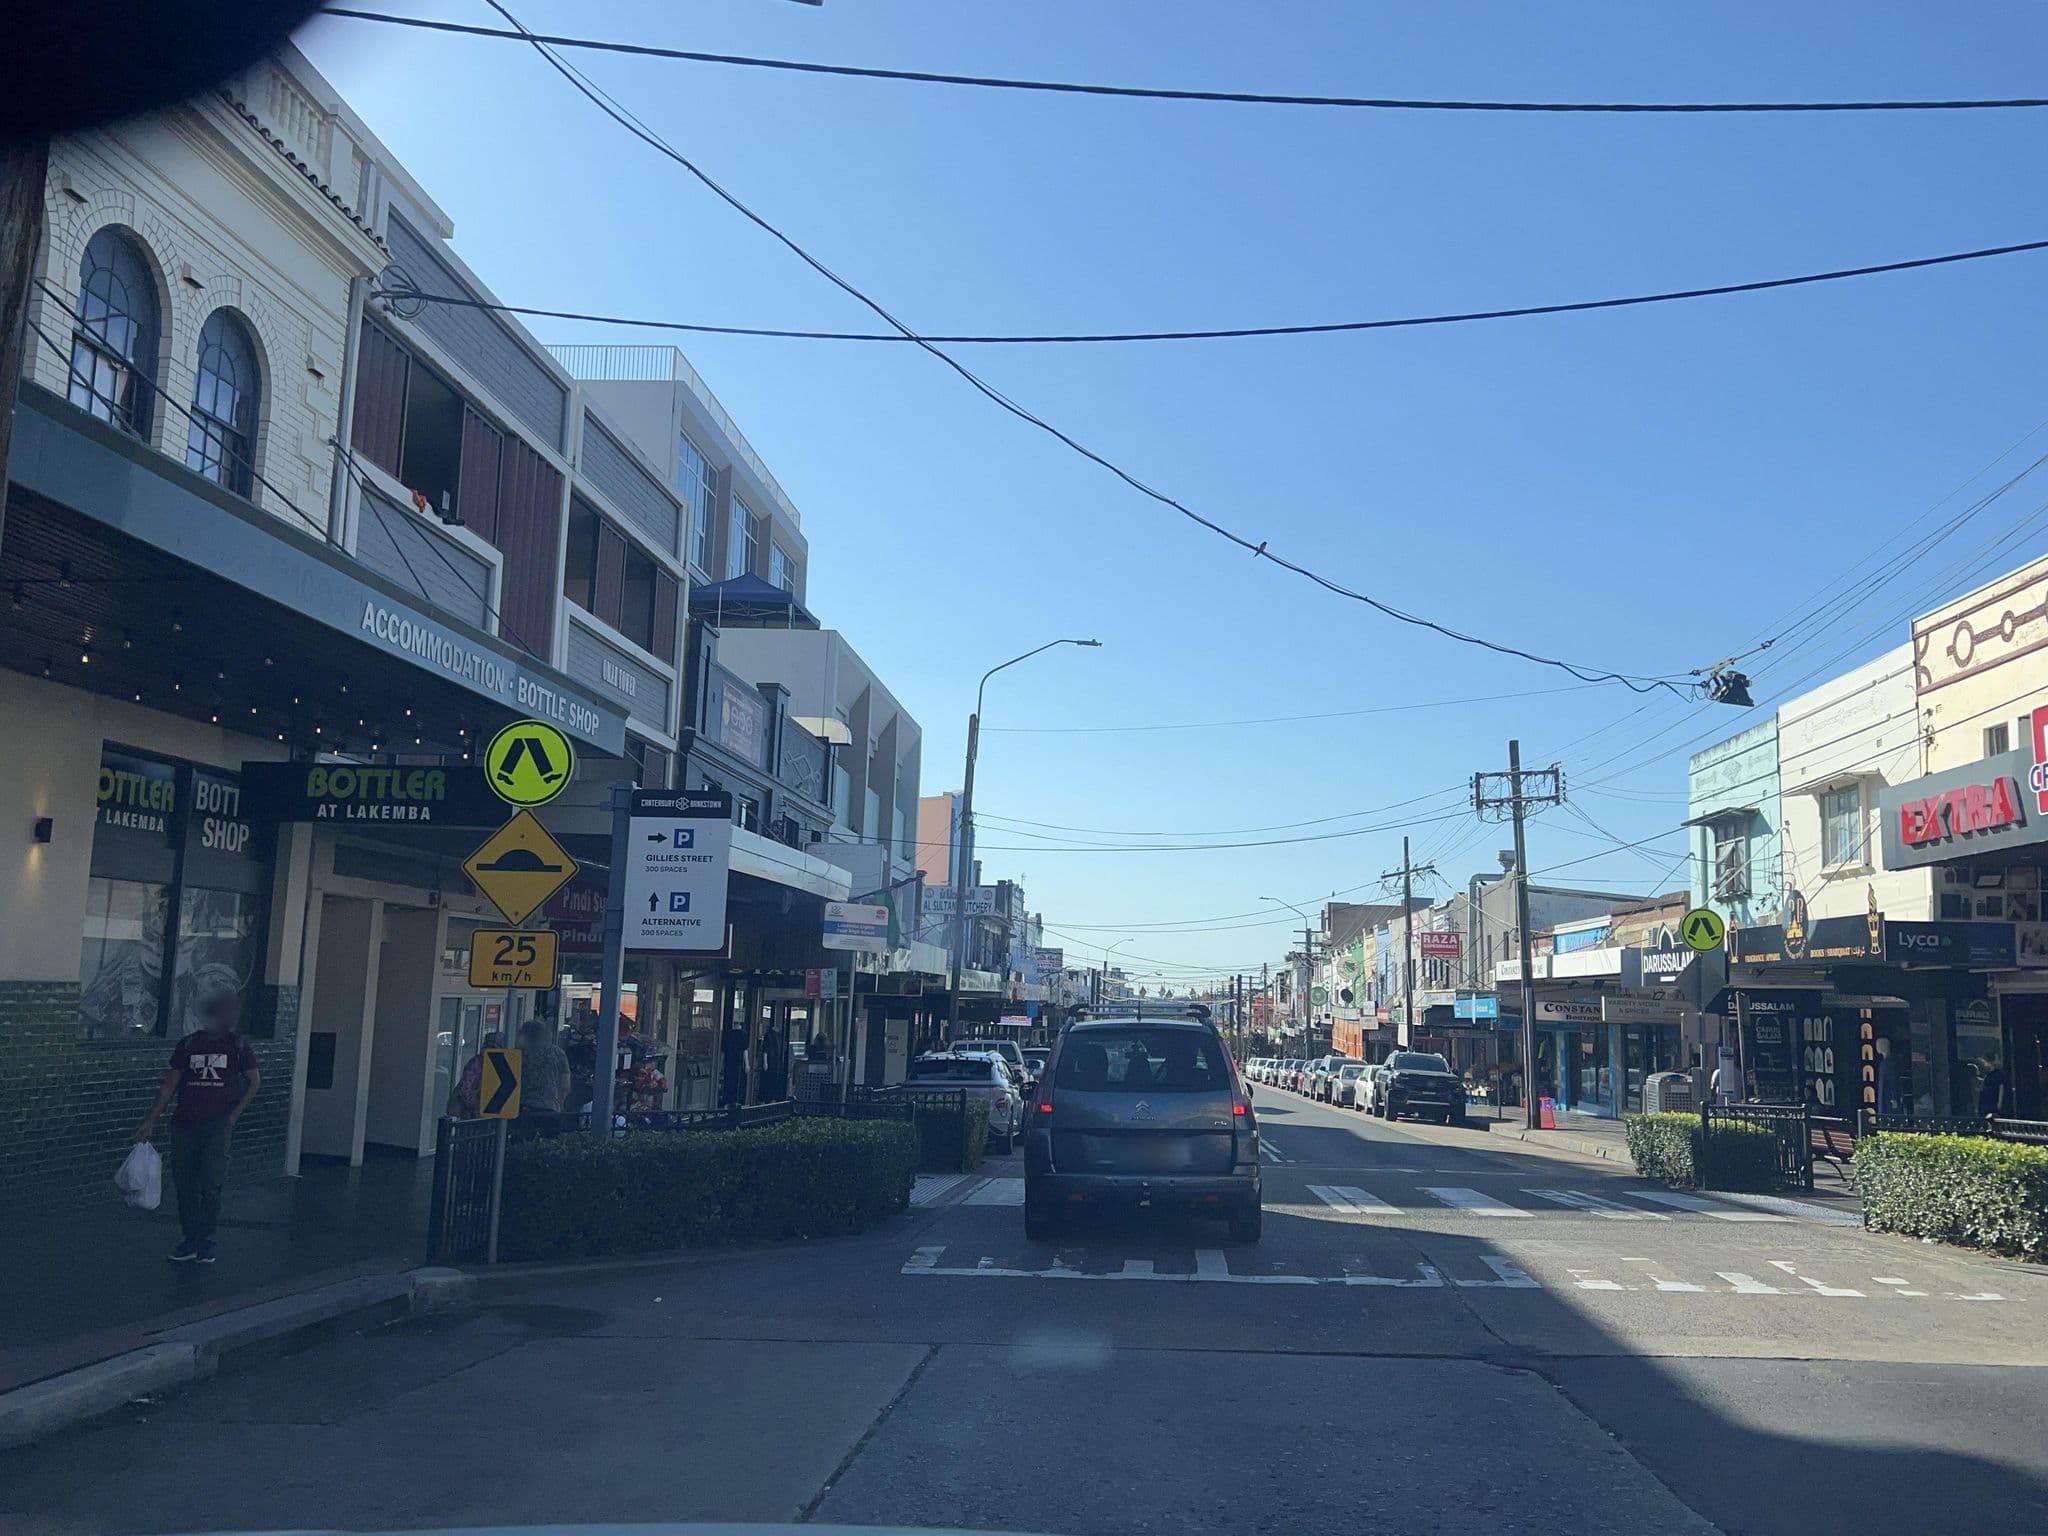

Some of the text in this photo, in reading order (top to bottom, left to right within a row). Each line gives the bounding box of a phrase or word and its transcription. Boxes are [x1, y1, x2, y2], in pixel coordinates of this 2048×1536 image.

[361, 601, 600, 736] ACCOMMODATION BOTTLE SHOP
[307, 766, 446, 801] BOTTLER
[317, 804, 431, 820] AT LAKEMBA
[1900, 776, 2020, 846] EXTRA
[106, 808, 164, 833] LAKEMBA
[202, 818, 249, 852] SHOP
[678, 831, 690, 846] P
[646, 854, 714, 863] GILLIES STREET
[673, 895, 686, 909] P
[923, 902, 931, 911] AL
[964, 902, 992, 913] UTCHERY
[641, 918, 702, 927] ALTERNATIVE
[656, 929, 684, 937] SPACES
[1423, 934, 1458, 944] RAZA
[1899, 931, 1940, 948] Lyca
[493, 935, 537, 967] 25
[491, 969, 532, 983] km/h
[1544, 1003, 1601, 1014] CONSTAN
